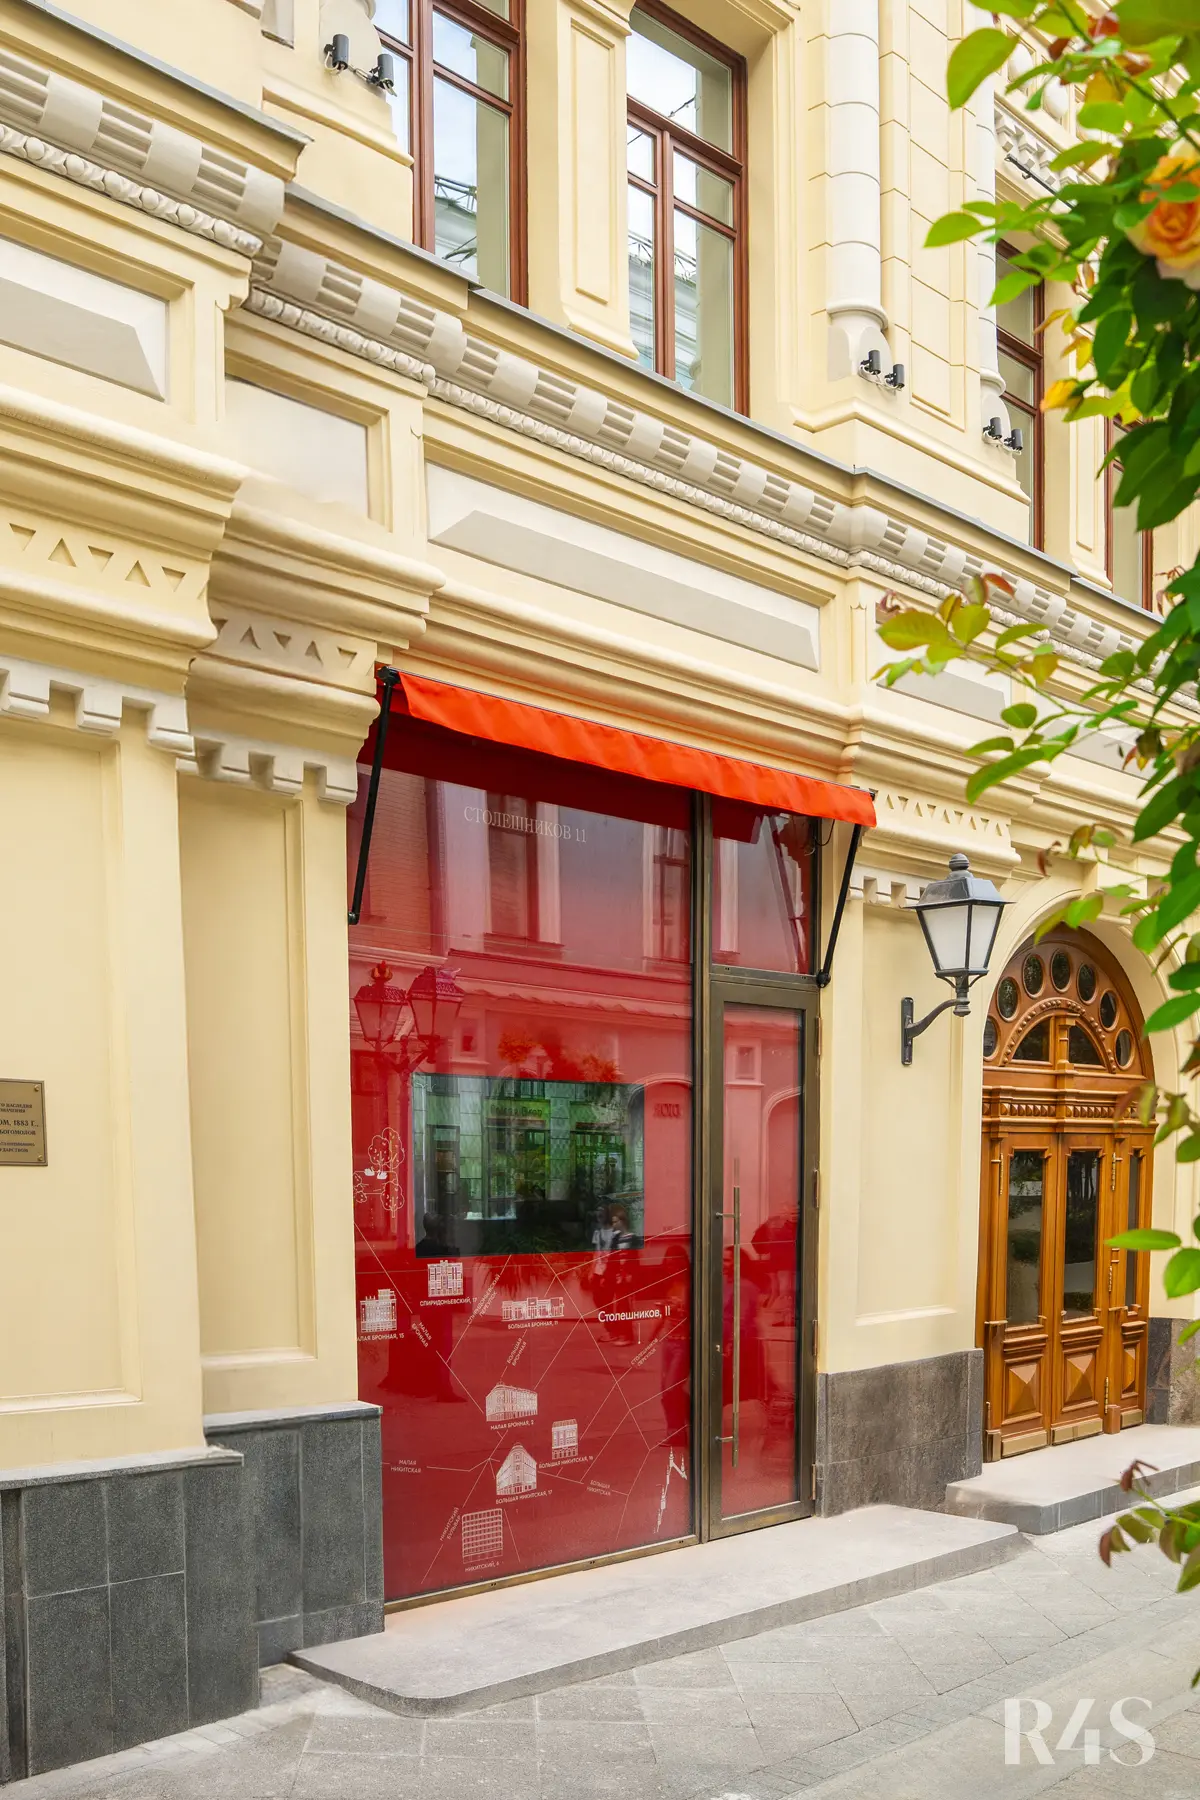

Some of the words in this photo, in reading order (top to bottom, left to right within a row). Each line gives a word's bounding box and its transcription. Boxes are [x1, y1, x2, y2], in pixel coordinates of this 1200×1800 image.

[463, 806, 572, 840] СТОЛЕШНИКОВ
[575, 828, 587, 843] 11
[13, 1119, 29, 1127] 1883
[597, 1308, 663, 1323] Столешников,
[418, 1321, 433, 1341] МАЛАЯ
[507, 1322, 531, 1330] БОЛЬШАЯ
[371, 1333, 399, 1341] БРОННАЯ,
[506, 1337, 523, 1364] БОЛЬШАЯ
[511, 1341, 527, 1367] БРОННАЯ
[507, 1420, 532, 1429] БРОННАЯ,
[390, 1466, 422, 1474] НИКИТСКАЯ
[538, 1461, 561, 1469] БОЛЬШАЯ
[495, 1496, 519, 1505] БОЛЬШАЯ
[518, 1491, 548, 1500] НИКИТСКАЯ,
[439, 1506, 460, 1542] НИКИТСКИЙ
